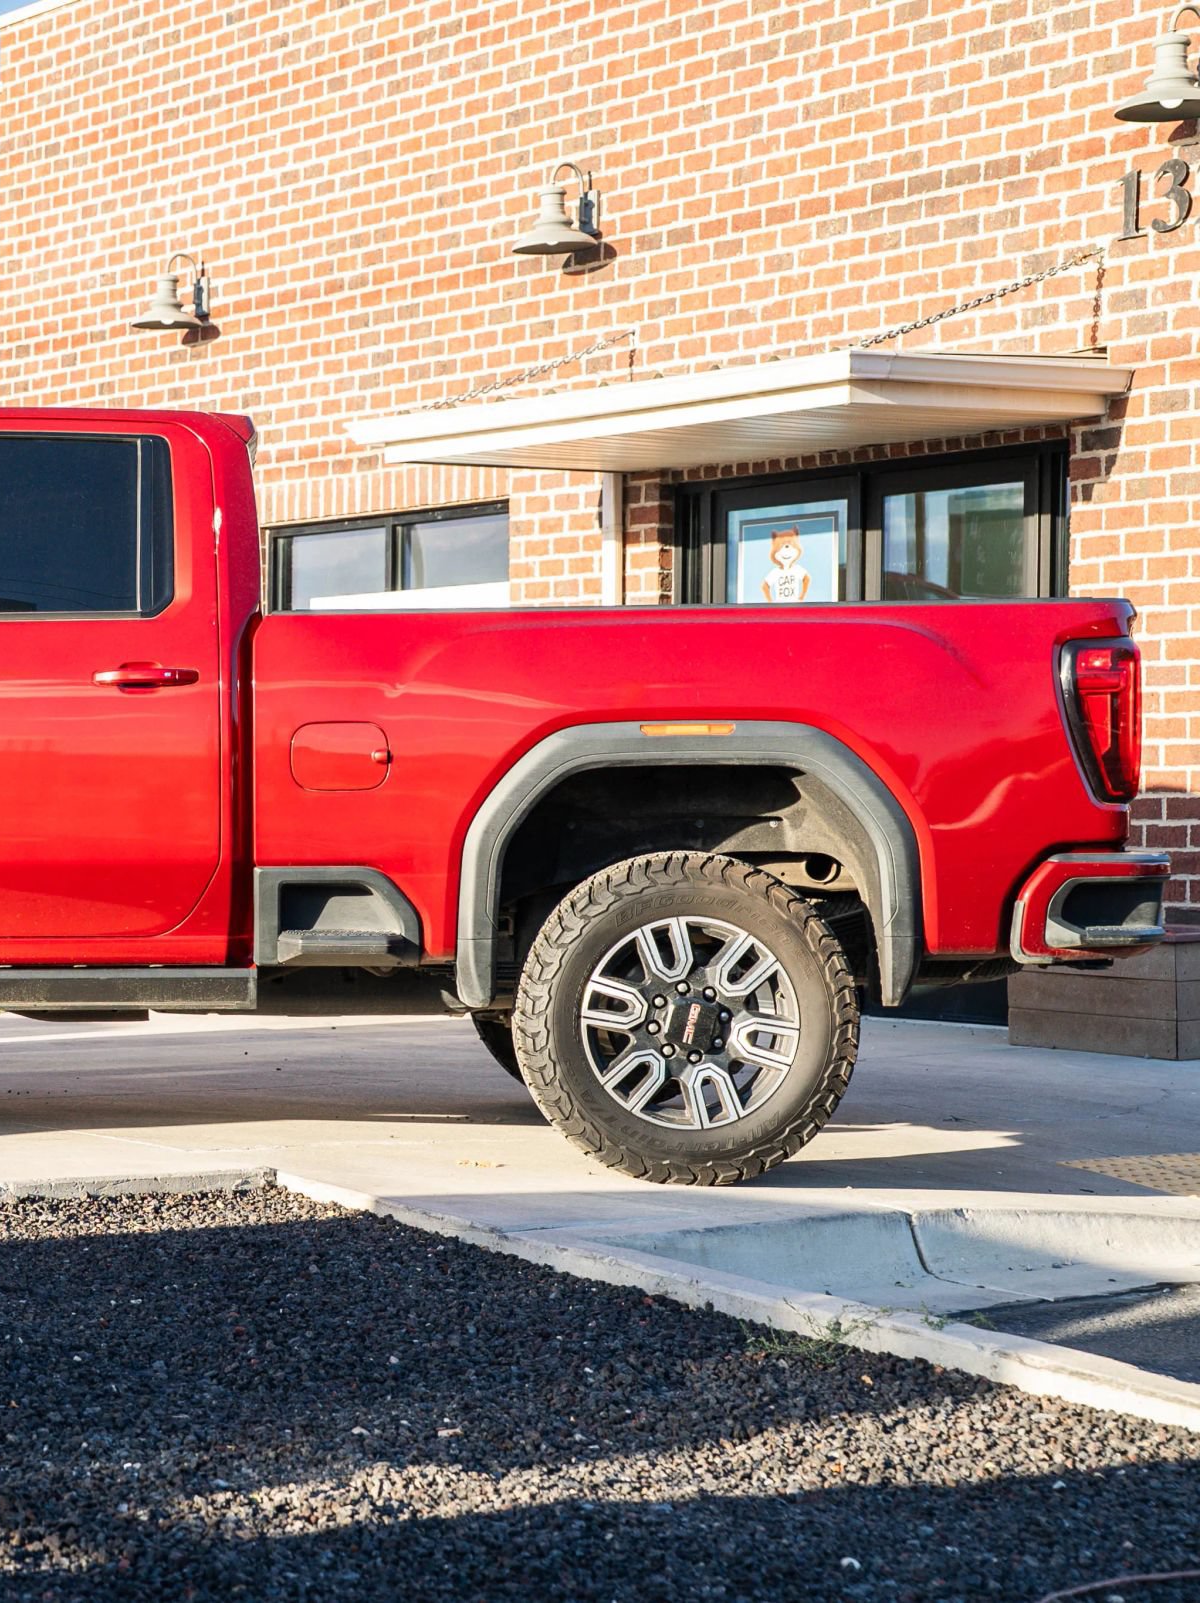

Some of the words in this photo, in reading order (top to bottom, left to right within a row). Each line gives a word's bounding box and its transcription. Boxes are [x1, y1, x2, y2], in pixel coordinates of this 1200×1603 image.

[1113, 159, 1200, 241] 13
[778, 587, 796, 598] FOX
[682, 1003, 701, 1045] GMC
